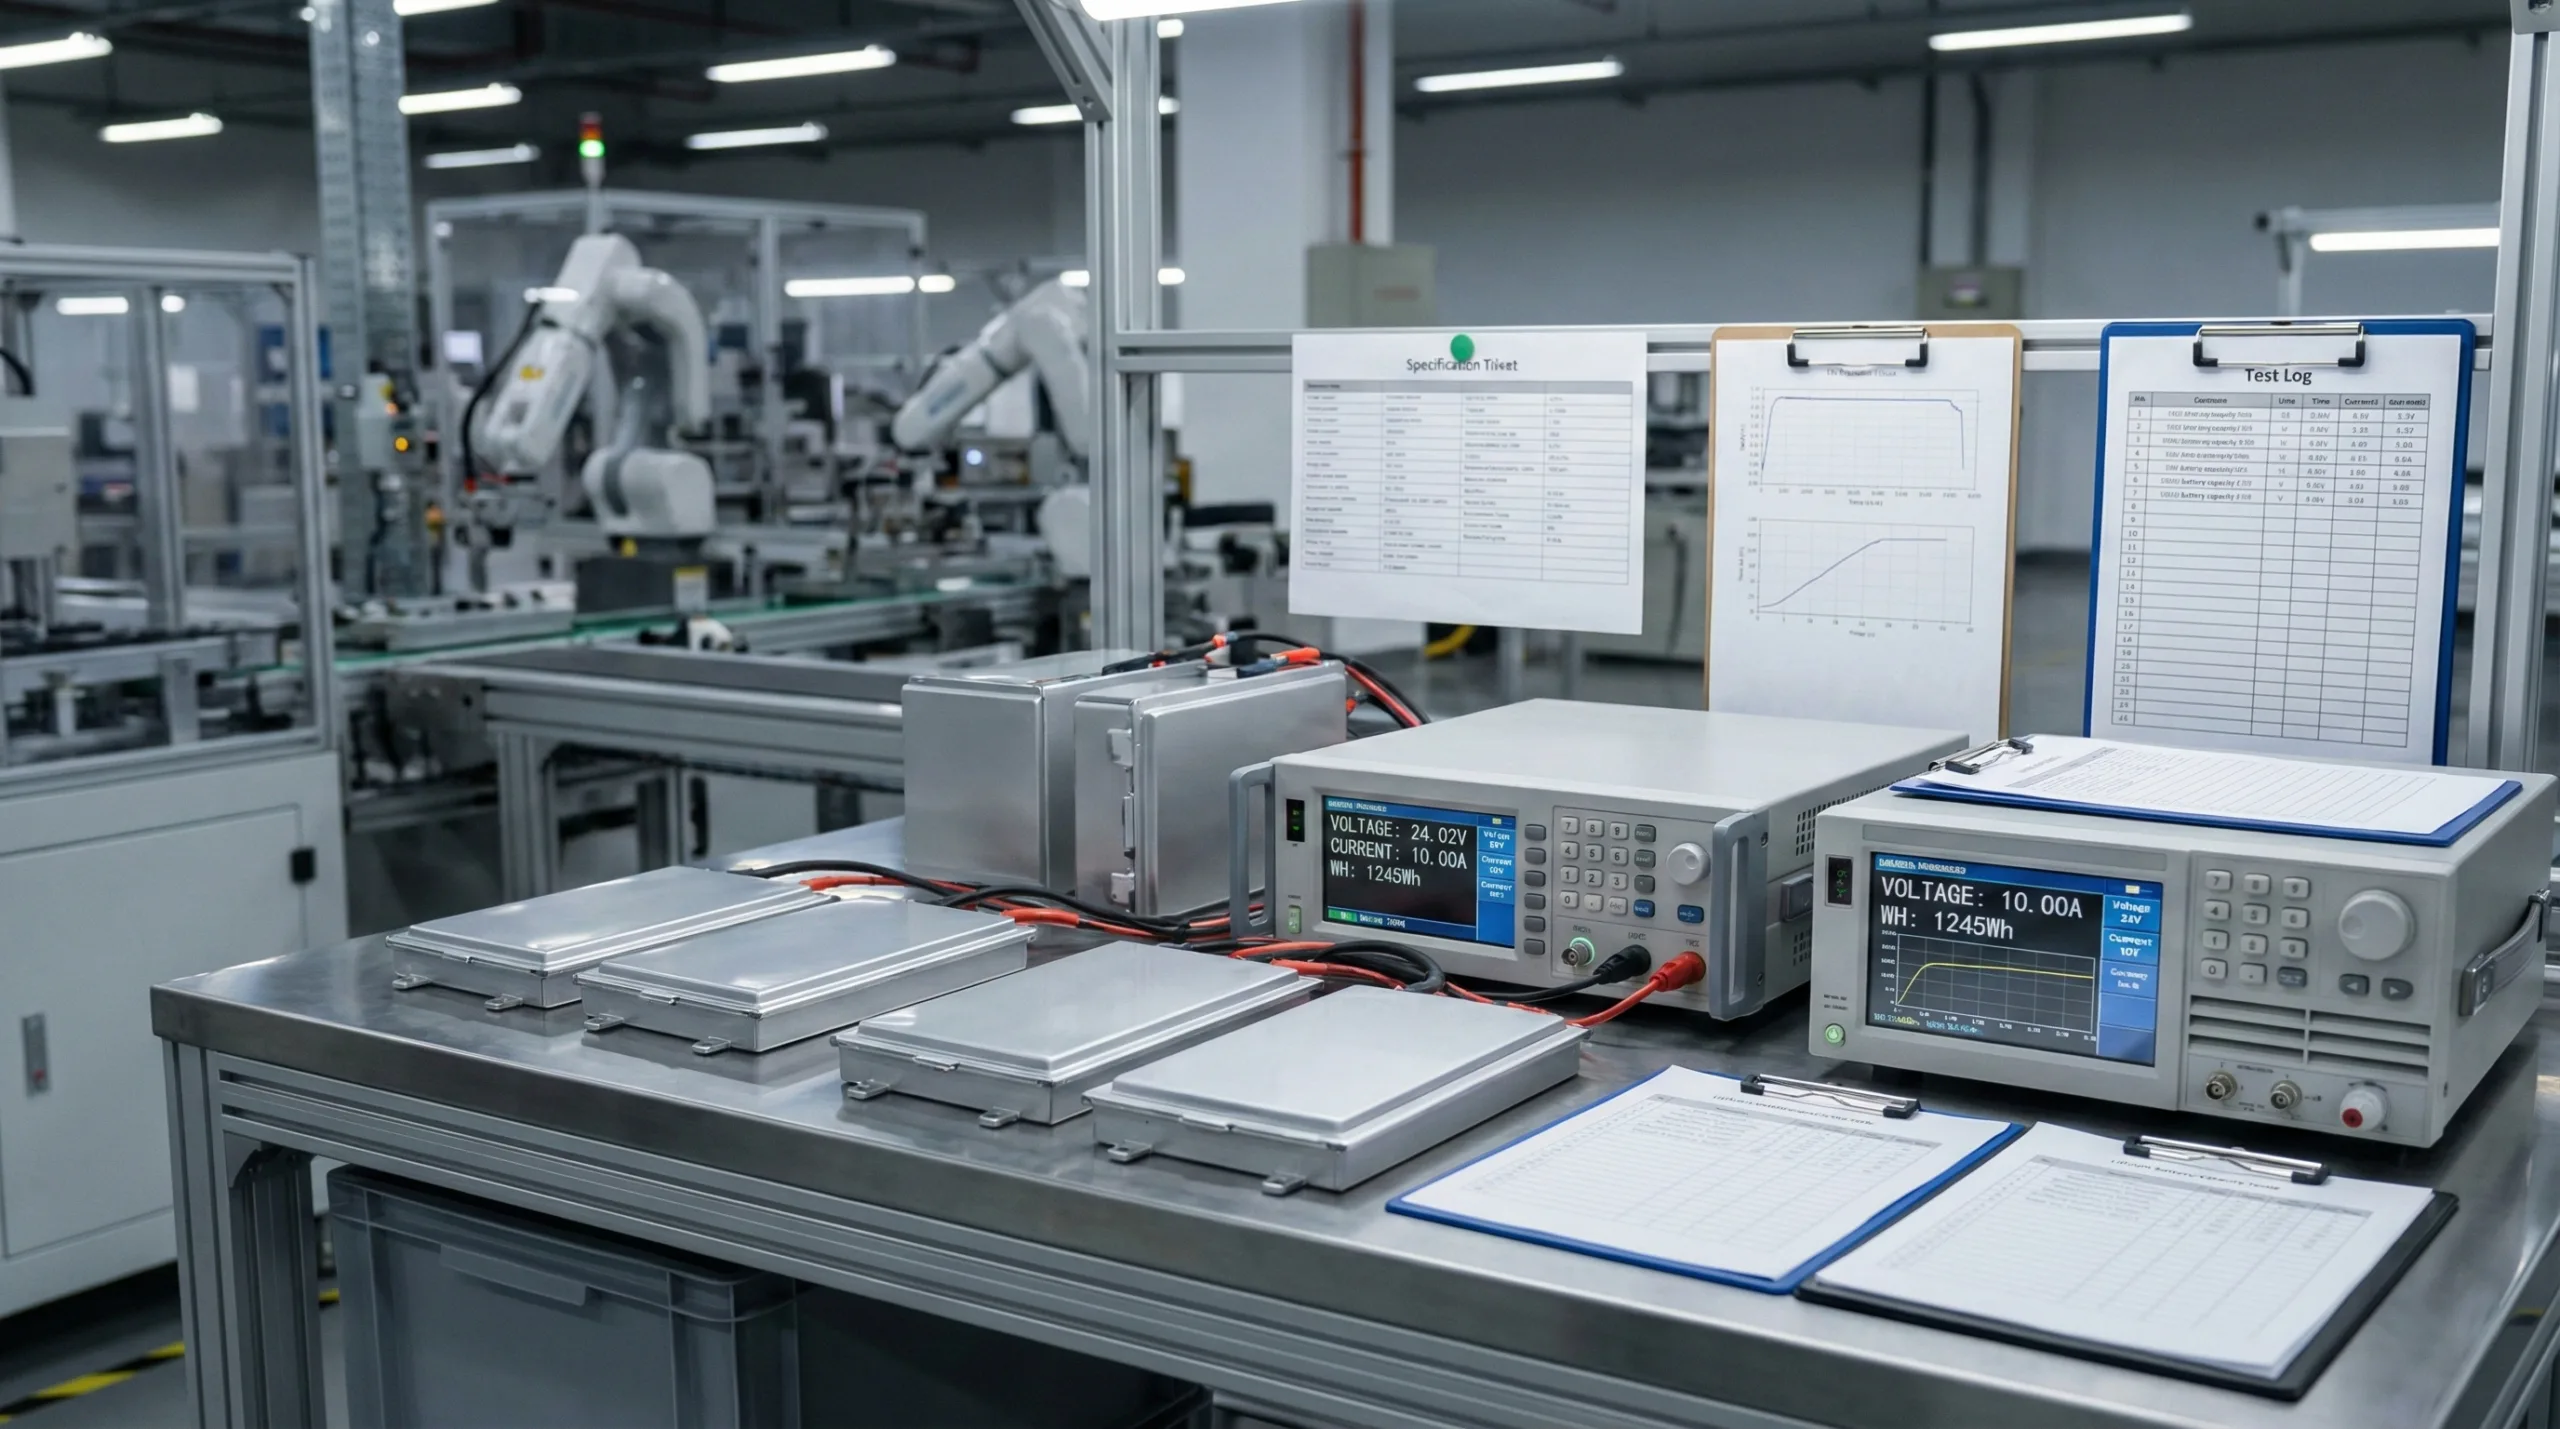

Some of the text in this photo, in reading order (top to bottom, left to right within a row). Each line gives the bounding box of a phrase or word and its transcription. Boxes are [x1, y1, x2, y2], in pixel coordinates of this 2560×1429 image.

[2245, 368, 2312, 385] Test Log
[1330, 814, 1400, 838] VOLTAGE:
[1411, 824, 1467, 846] 24.02V
[1565, 821, 1572, 830] 7
[1589, 824, 1595, 833] 8
[1614, 827, 1620, 836] 9
[1330, 837, 1467, 869] CURRENT: 10.00A
[1564, 846, 1571, 855] 4
[1589, 849, 1595, 858] 5
[1614, 851, 1620, 860] 6
[1330, 859, 1421, 886] WH: 1245Wh
[1565, 871, 1570, 880] 1
[1588, 874, 1595, 883] 2
[1613, 876, 1620, 886] 3
[2214, 876, 2220, 886] 7
[1564, 895, 1571, 904] 0
[1881, 876, 2083, 918] VOLTAGE: 10.00A
[2210, 906, 2218, 916] 4
[1880, 904, 2013, 940] WH: 1245Wh
[2208, 965, 2216, 975] 0
